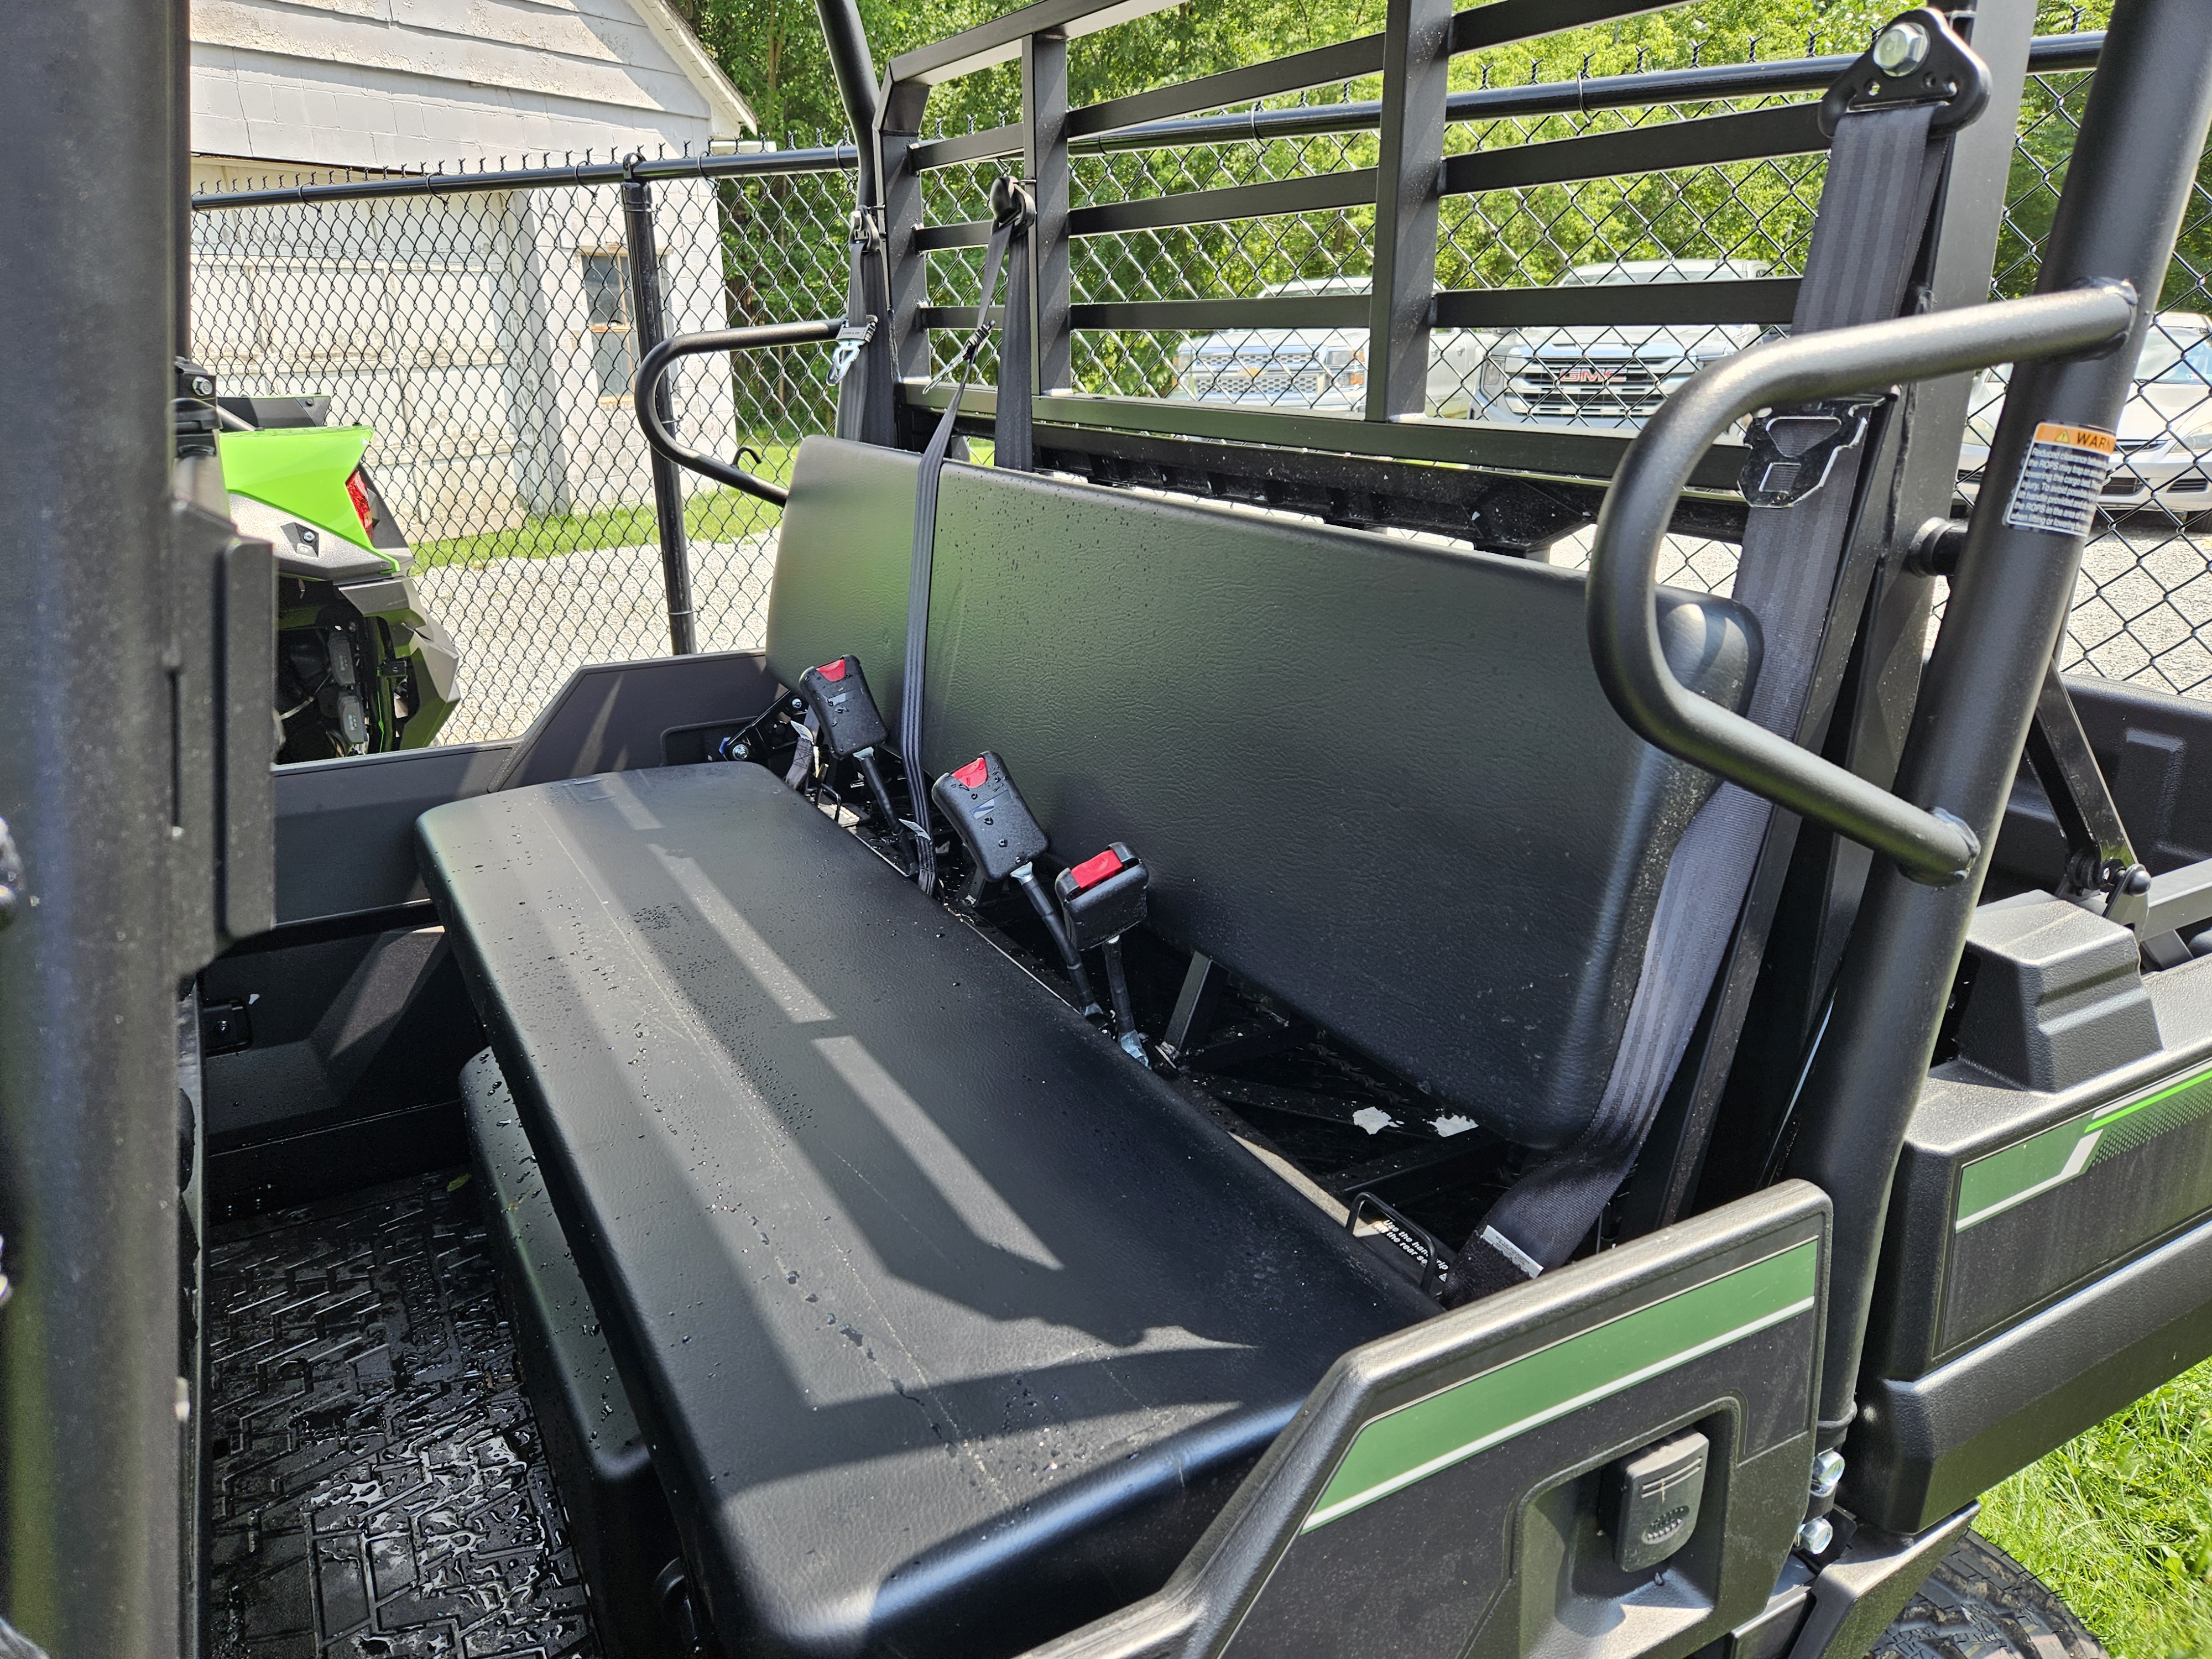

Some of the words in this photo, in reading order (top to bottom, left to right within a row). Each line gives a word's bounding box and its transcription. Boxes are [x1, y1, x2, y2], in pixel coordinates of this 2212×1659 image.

[1559, 368, 1627, 382] GMC
[2032, 447, 2060, 459] Reduced
[2039, 460, 2059, 469] ROPS
[2059, 464, 2072, 473] may
[2025, 469, 2053, 482] lowering
[2064, 477, 2081, 487] cargo
[2051, 484, 2068, 493] avoid
[2026, 492, 2048, 502] handle
[2048, 495, 2074, 508] provided
[2026, 502, 2046, 512] ROPS
[2011, 512, 2028, 520] when
[1383, 1219, 1399, 1232] Use
[1398, 1231, 1413, 1243] the
[1386, 1232, 1401, 1243] the
[1400, 1242, 1418, 1255] rear
